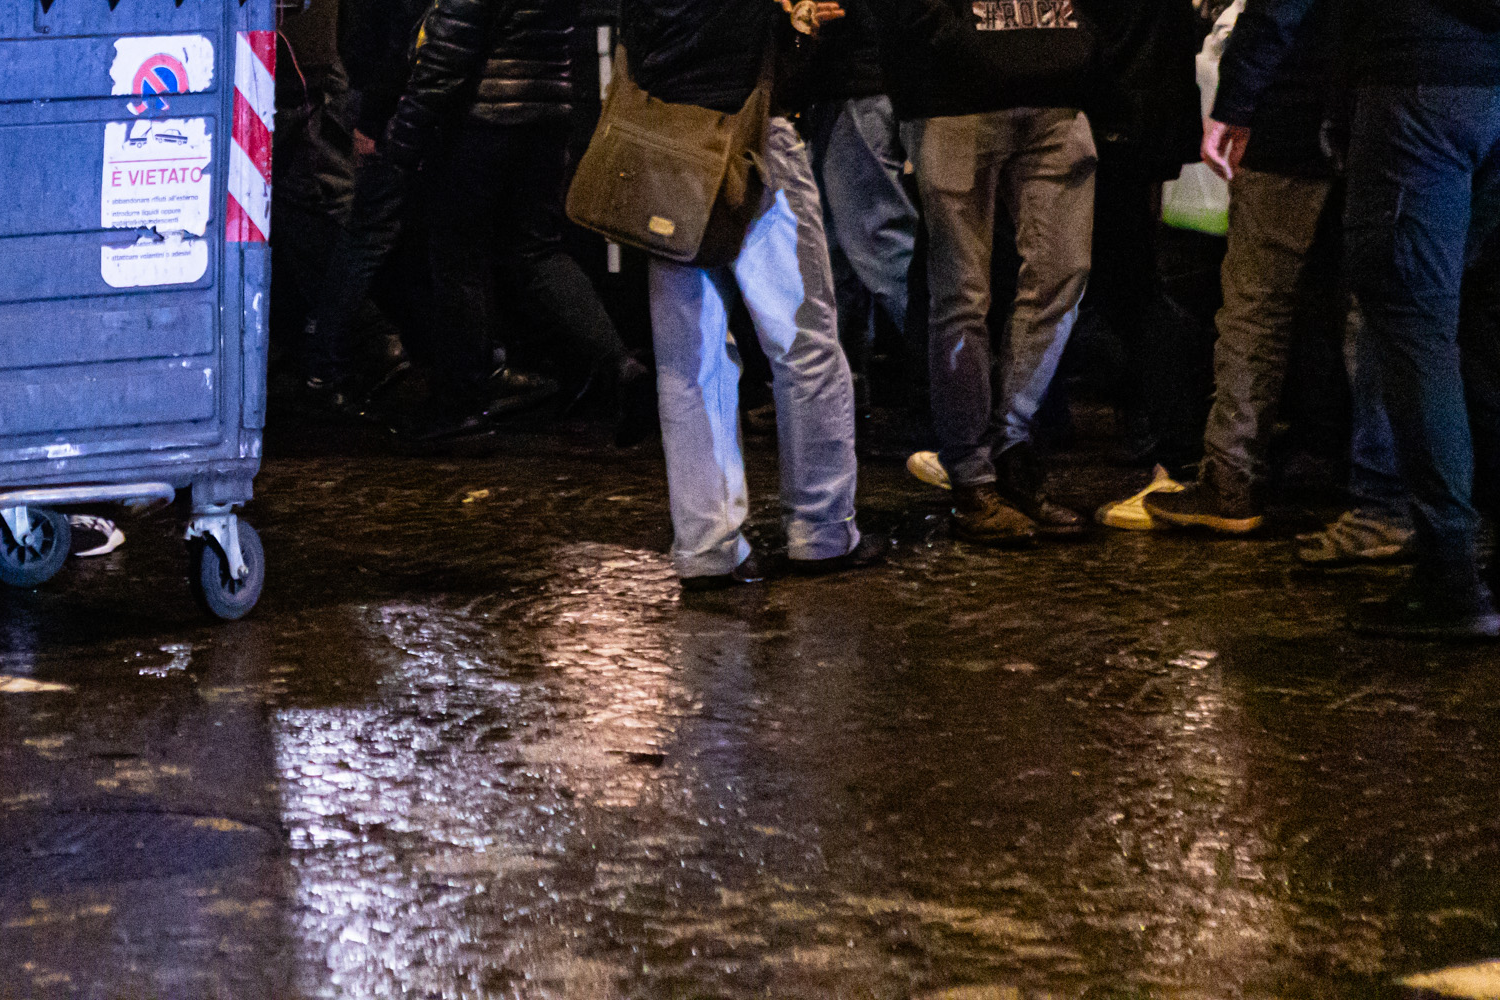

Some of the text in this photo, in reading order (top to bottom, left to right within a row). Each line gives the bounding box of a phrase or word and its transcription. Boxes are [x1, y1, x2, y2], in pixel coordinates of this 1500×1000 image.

[983, 0, 1071, 29] #ROCK
[111, 166, 204, 187] È VIETATO
[111, 196, 150, 205] abbandonare
[168, 194, 199, 202] all'esterno
[141, 208, 159, 217] liquidi
[160, 208, 182, 216] oppure
[111, 254, 139, 262] attaccare
[140, 252, 165, 260] volantini
[171, 250, 192, 258] adesivi
